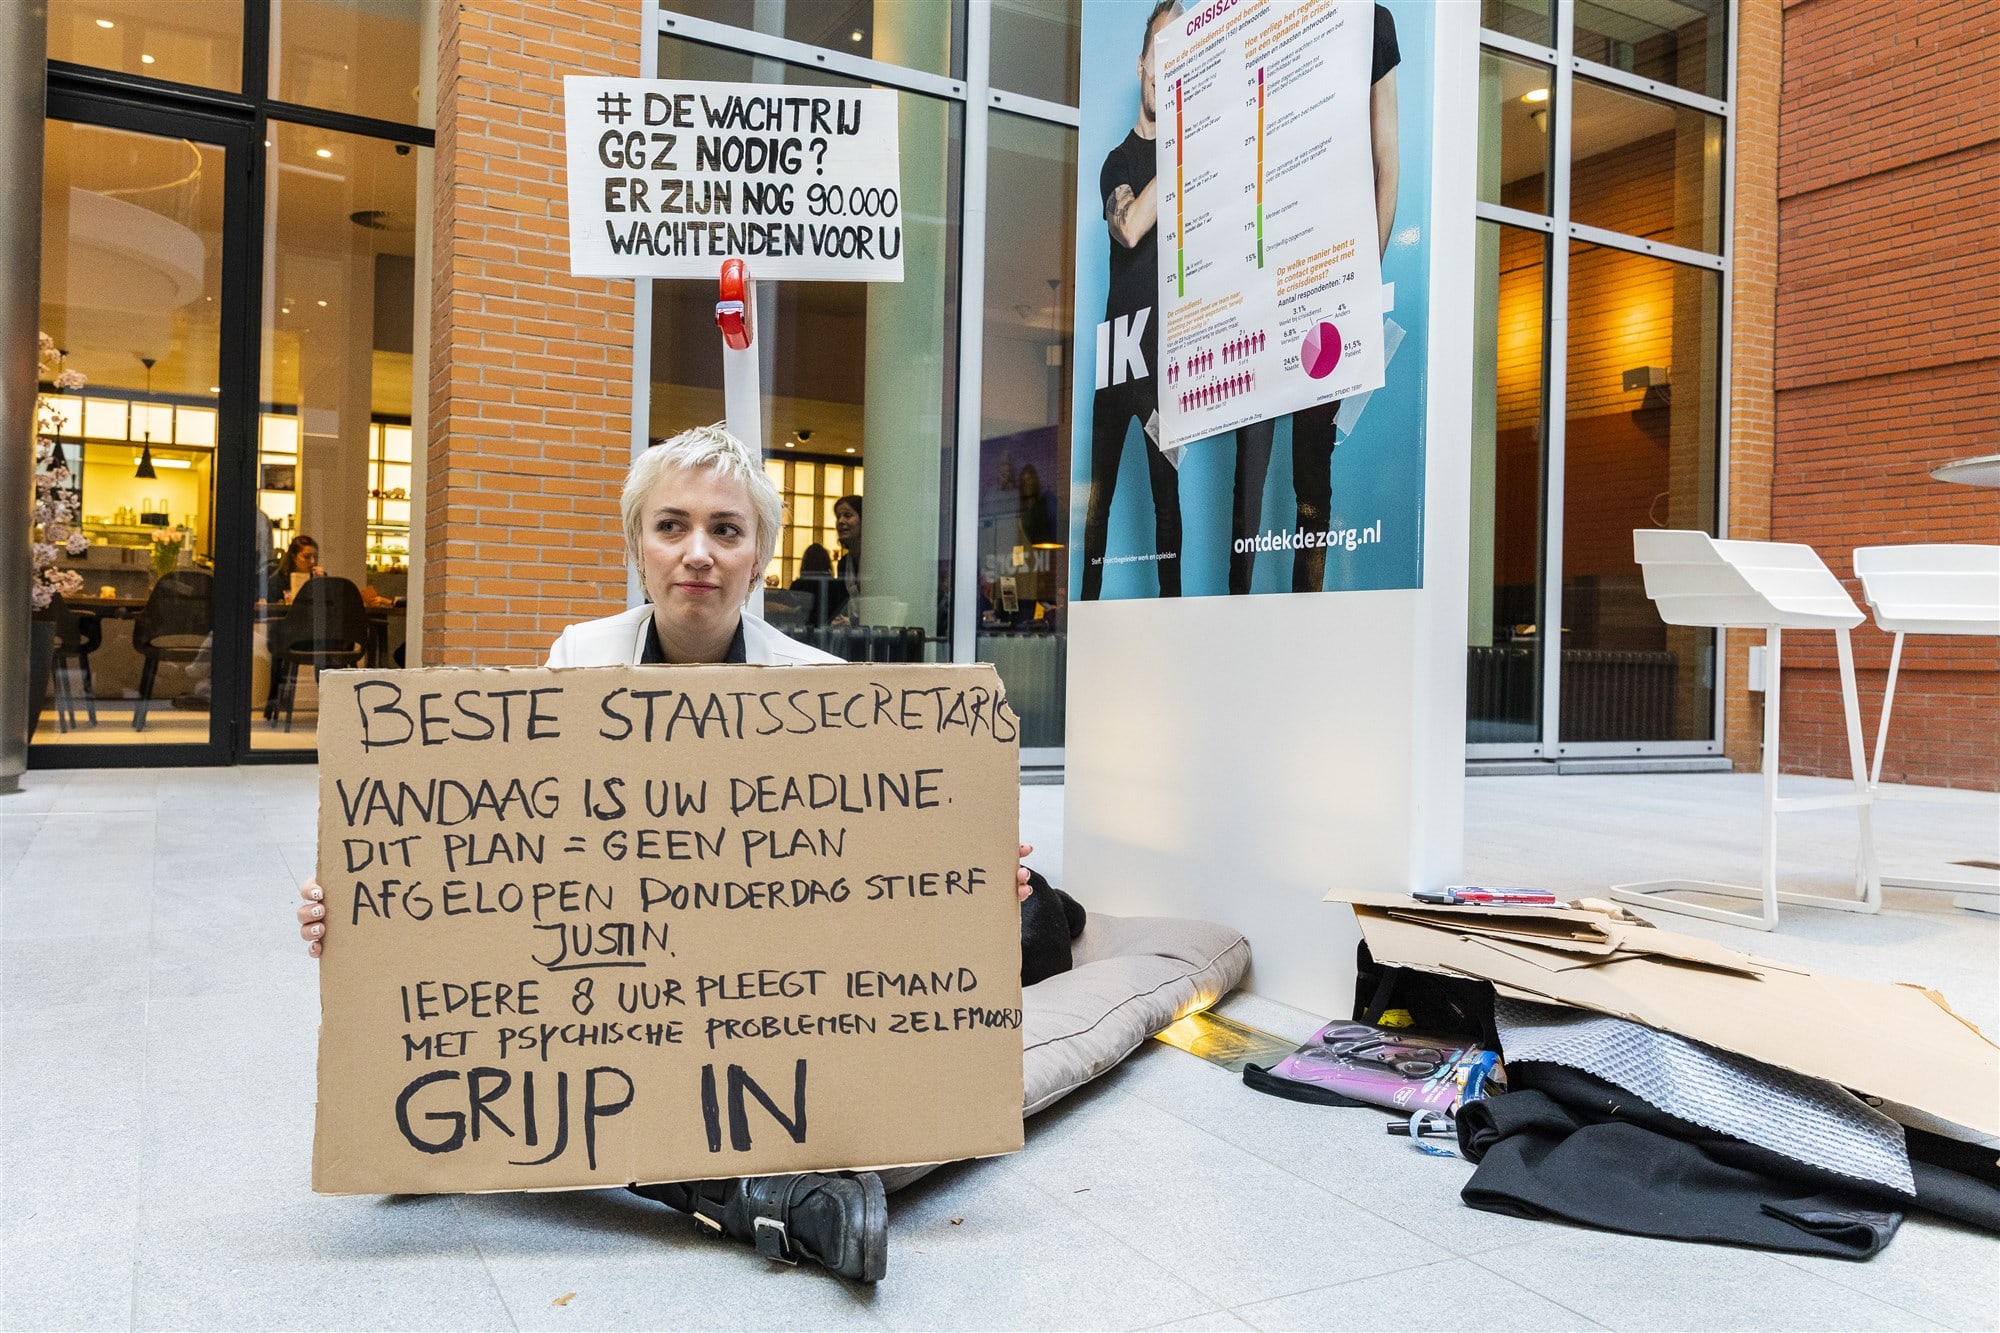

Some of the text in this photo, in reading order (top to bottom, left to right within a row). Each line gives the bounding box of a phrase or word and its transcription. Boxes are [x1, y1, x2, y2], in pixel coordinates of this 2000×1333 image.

[1164, 60, 1175, 71] Kon
[1181, 50, 1188, 60] de
[1190, 24, 1224, 54] crisisdienst
[1226, 12, 1242, 32] goed
[1244, 0, 1270, 18] bereike
[1204, 36, 1225, 54] naasten
[1244, 36, 1258, 48] Hoe
[1260, 20, 1282, 39] verliep
[1284, 9, 1296, 24] het
[1245, 47, 1256, 60] van
[1258, 38, 1270, 51] een
[1272, 20, 1300, 42] opname
[1302, 14, 1308, 24] in
[1272, 45, 1278, 53] en
[1279, 30, 1301, 49] naasten
[598, 93, 631, 124] #
[701, 95, 861, 135] WACHTRIJ
[599, 130, 676, 170] GGZ
[606, 178, 897, 217] ER ZIJN NOG 90.000
[606, 221, 900, 259] WACHTENDEN VOOR U
[1277, 266, 1285, 276] Op
[1287, 258, 1306, 271] welke
[1308, 248, 1331, 263] manier
[1332, 240, 1348, 252] bent
[1277, 270, 1328, 296] de crisisdienst?
[1285, 266, 1308, 282] contact
[1310, 254, 1338, 274] geweest
[1340, 249, 1354, 260] met
[1278, 272, 1354, 307] Aantal respondenten: 748
[1293, 305, 1306, 314] 3.1%
[1338, 303, 1346, 311] 4%
[1096, 306, 1151, 389] IK
[1234, 520, 1381, 554] ontdekdezorg.nl
[354, 681, 1022, 753] BESTE STAATSSECRETARIS
[336, 769, 954, 826] VANDAAG IS UW DEADLINE.
[344, 827, 846, 873] DIT PLAN = GEEN PLAN
[352, 868, 985, 927] AFGELOPEN DONDERDAG STIERF
[532, 922, 676, 969] JUSTIN.
[402, 969, 977, 1022] IEDERE 8 UUR PLEEGT IEMAND
[402, 1007, 1022, 1061] MET PSYCHISCHE PROBLEMEN ZELFMOORD
[396, 1059, 806, 1170] GRIJP IN
